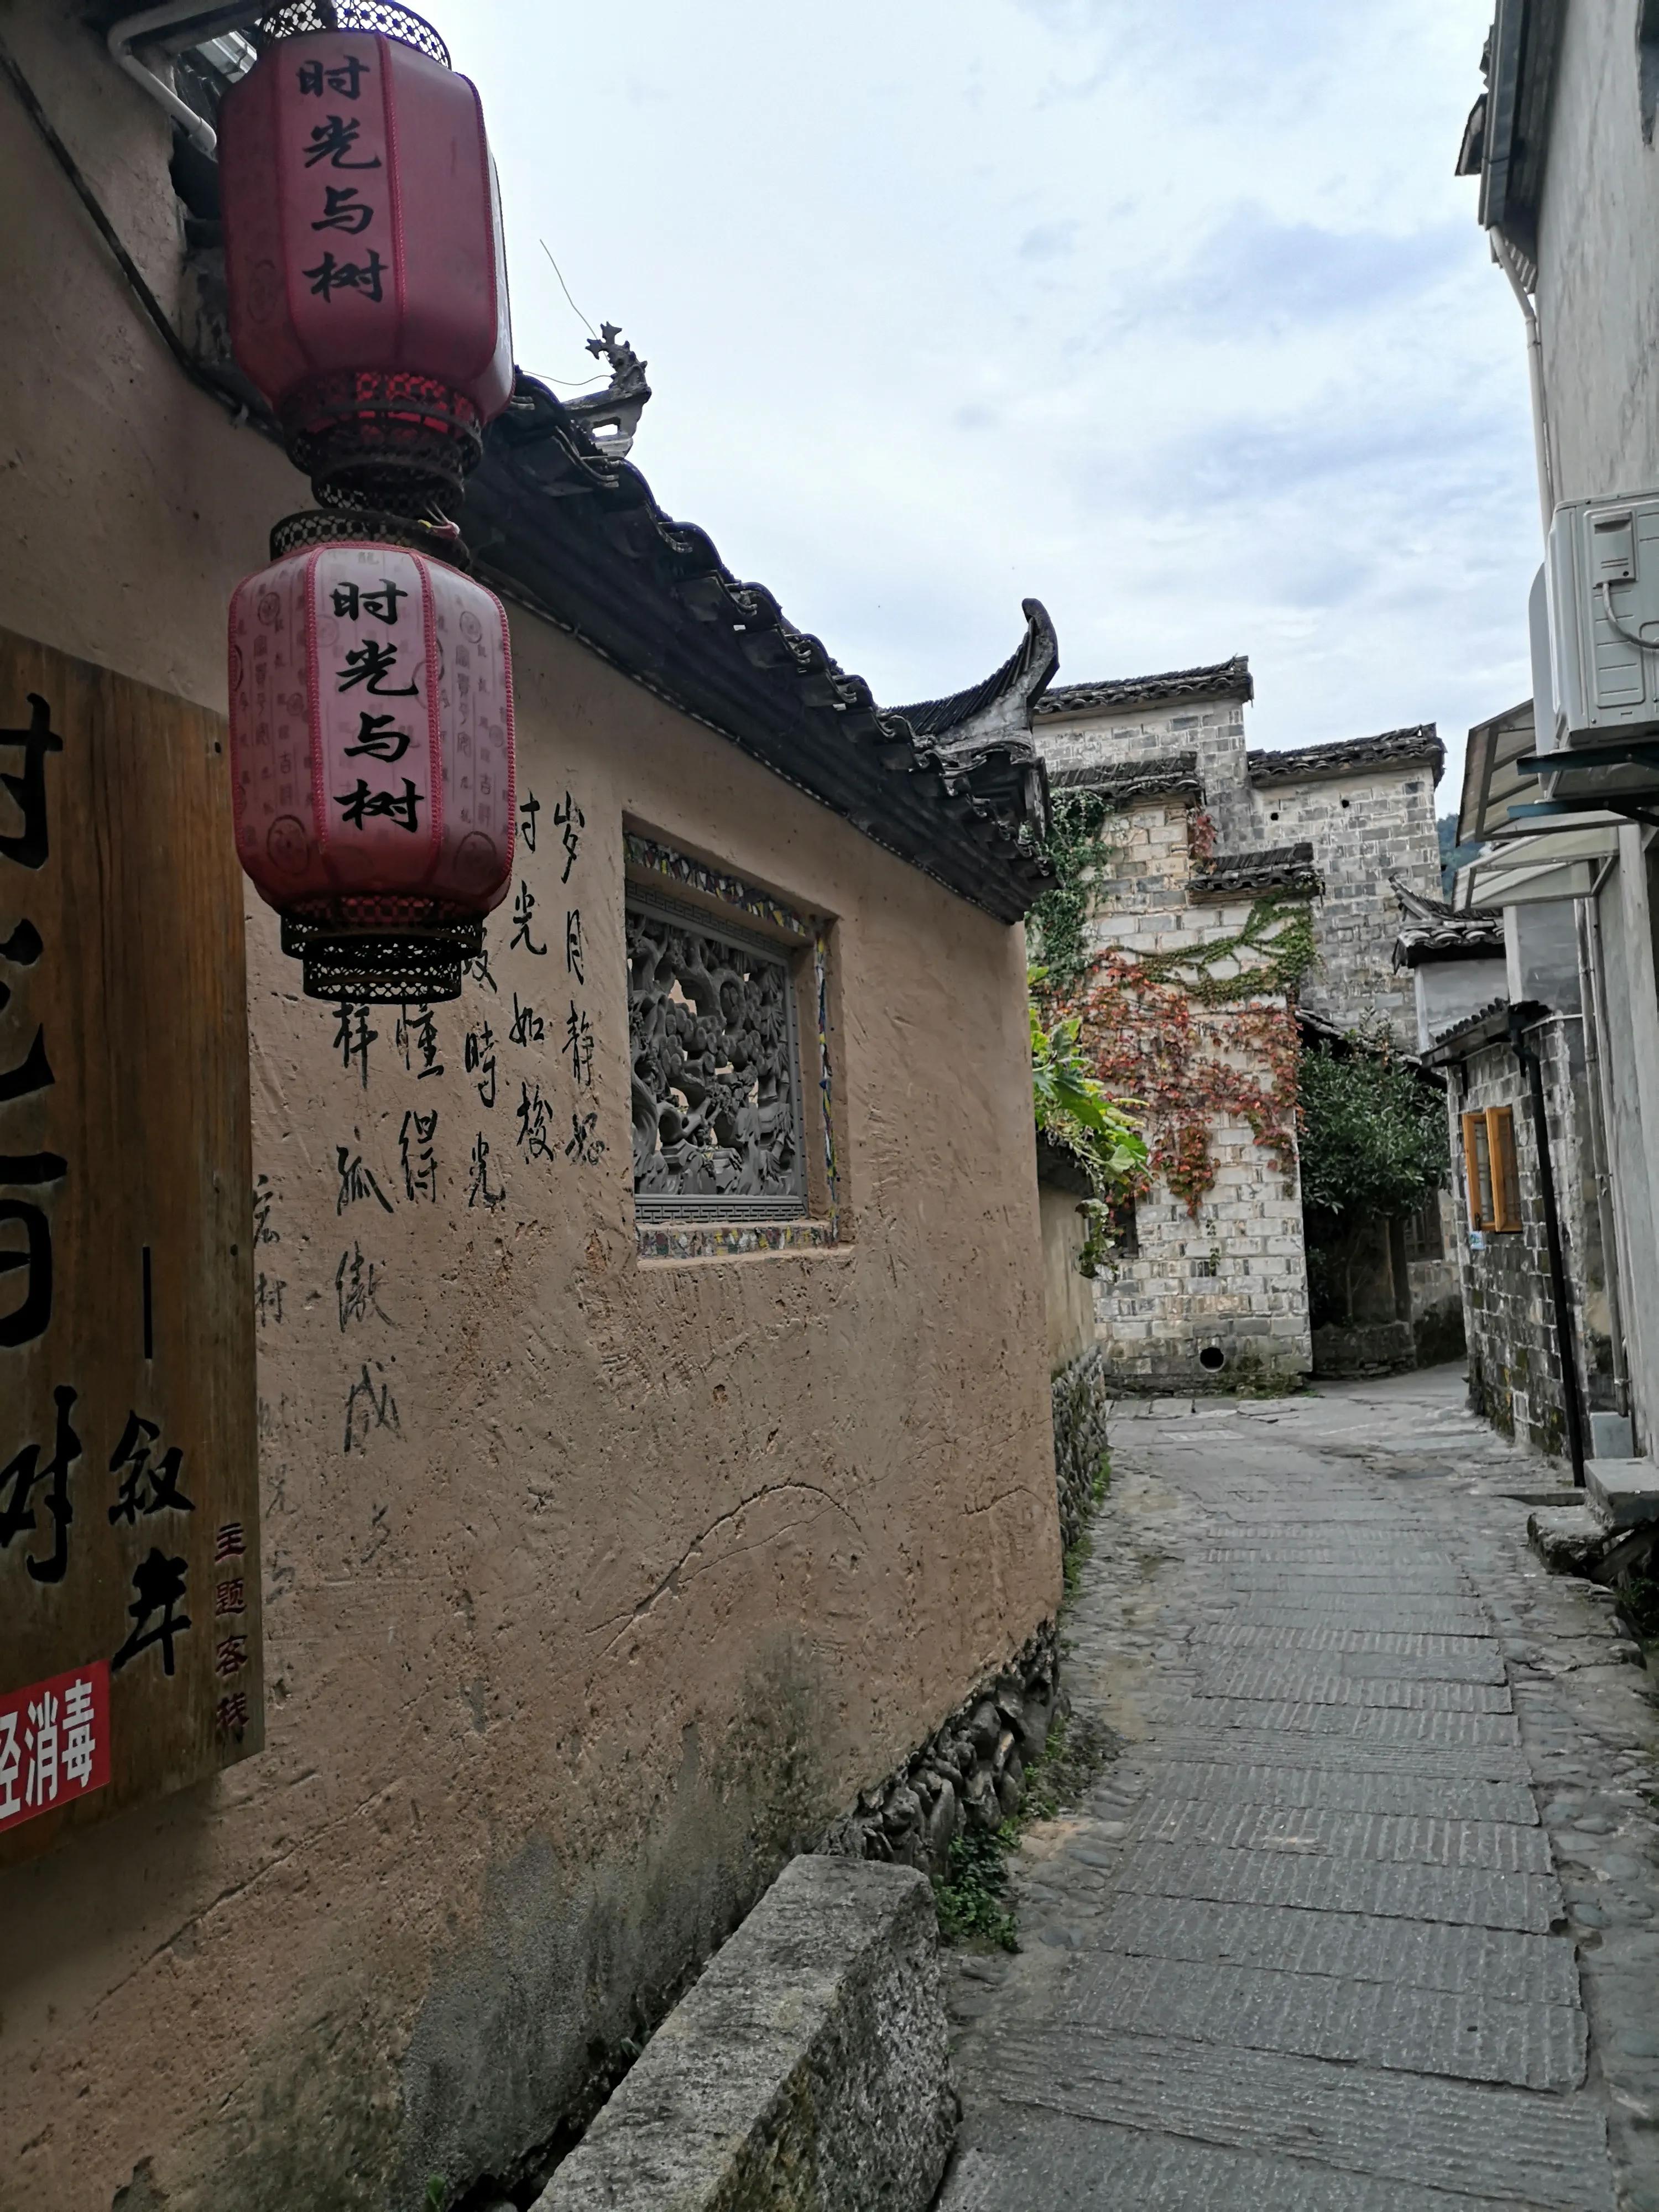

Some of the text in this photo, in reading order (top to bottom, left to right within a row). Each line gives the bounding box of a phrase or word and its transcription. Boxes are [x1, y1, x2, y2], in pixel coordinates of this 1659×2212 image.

[295, 56, 390, 304] 时光与树
[329, 578, 425, 833] 时光与树
[215, 1522, 249, 1743] 主题客栈
